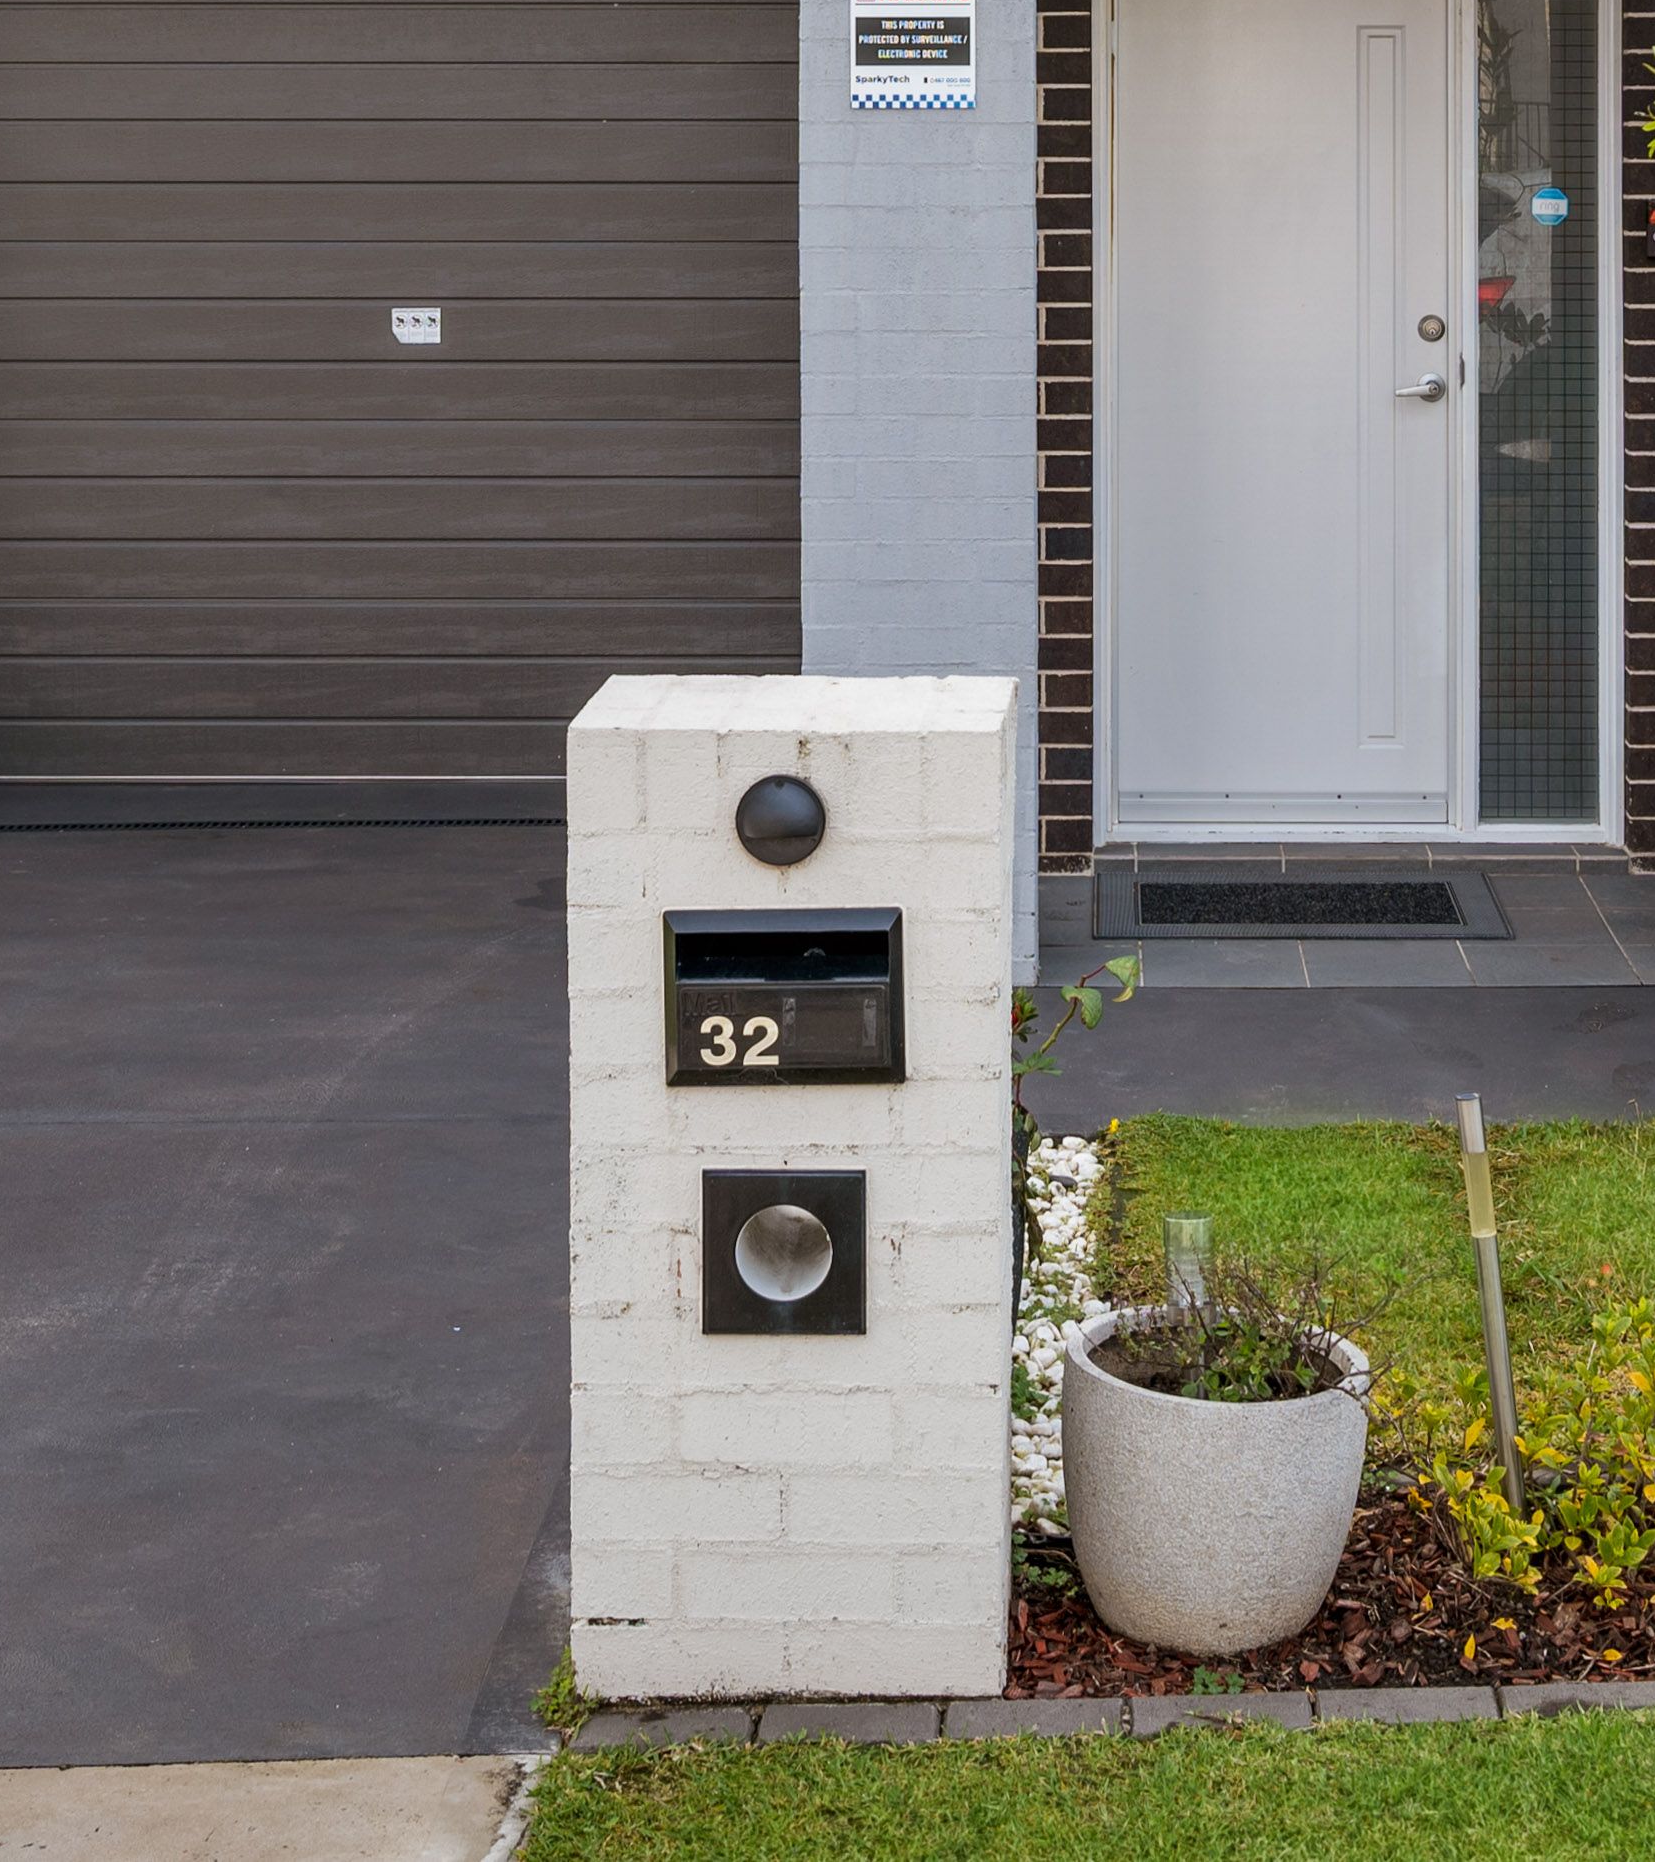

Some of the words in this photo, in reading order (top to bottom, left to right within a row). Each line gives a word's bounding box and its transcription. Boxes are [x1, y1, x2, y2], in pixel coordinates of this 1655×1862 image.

[881, 20, 898, 29] THIS
[899, 20, 935, 29] PROPERTY
[936, 20, 945, 29] IS
[858, 35, 899, 44] PROTECTED
[900, 35, 910, 44] BY
[911, 35, 962, 44] SURVEILLANCE
[878, 49, 921, 58] ELECTRONIC
[922, 49, 948, 58] DEVICE
[855, 75, 910, 84] SparkyTech
[1539, 201, 1560, 213] ring
[700, 1015, 780, 1066] 32
